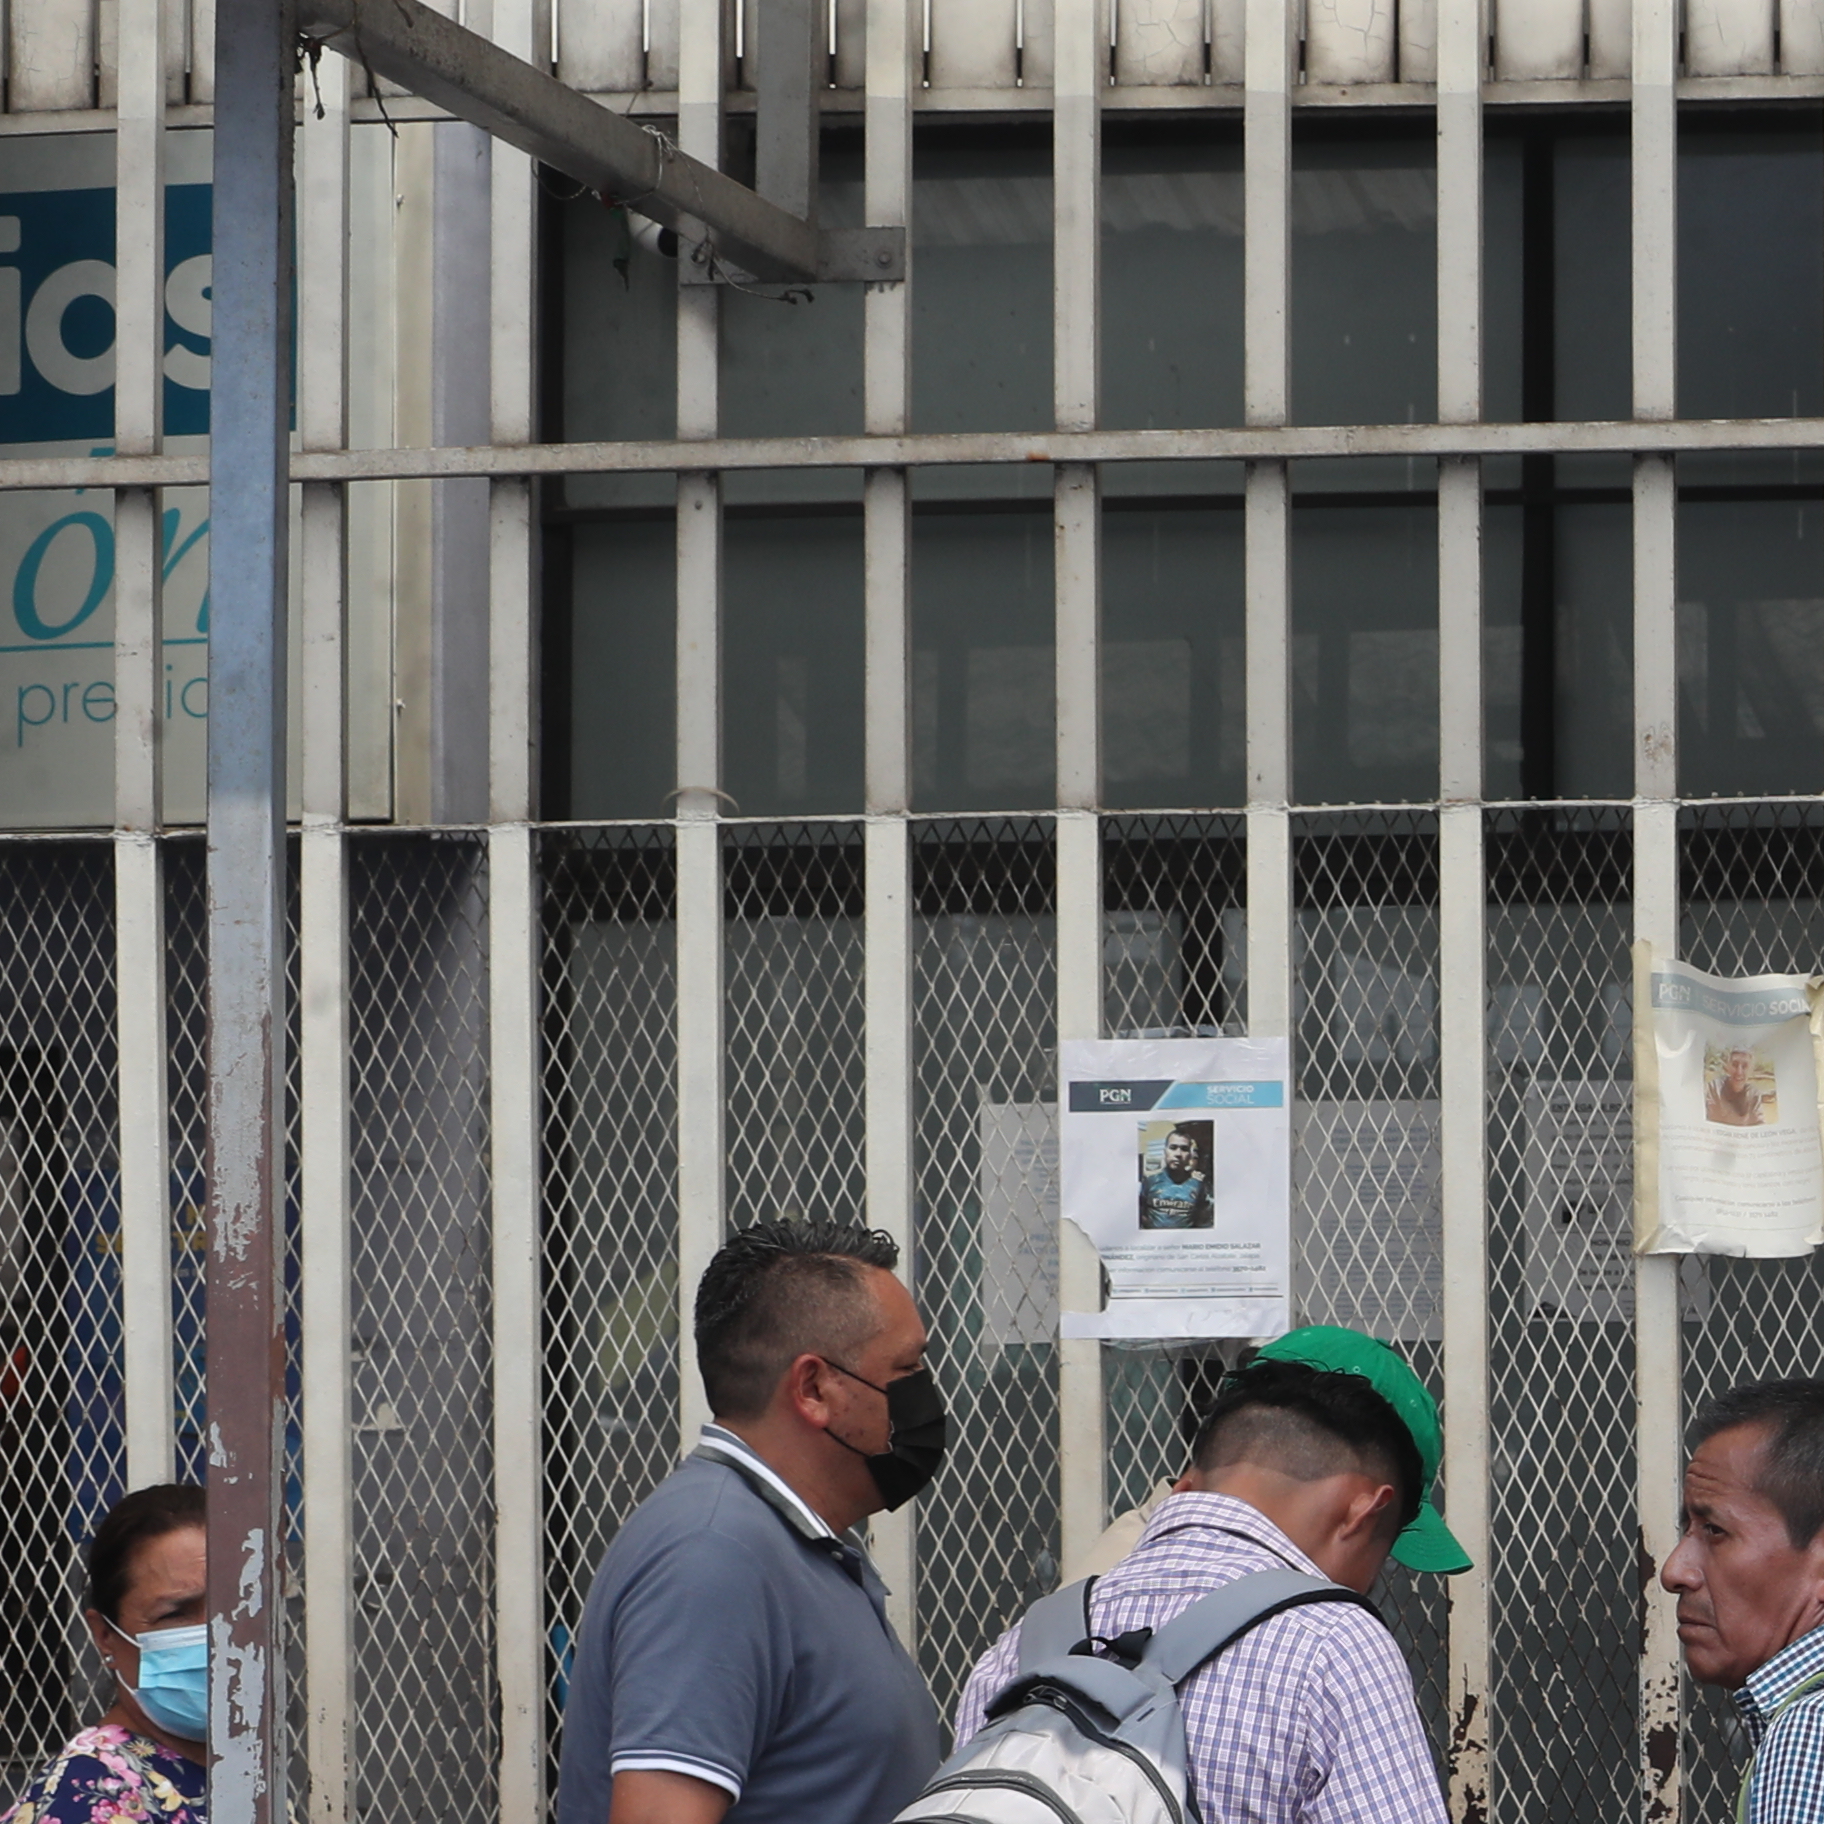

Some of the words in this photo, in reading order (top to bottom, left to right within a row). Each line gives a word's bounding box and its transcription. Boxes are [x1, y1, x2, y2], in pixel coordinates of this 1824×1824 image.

[1658, 983, 1691, 1002] PGN
[1703, 995, 1766, 1018] SERVICIO
[1100, 1088, 1132, 1102] PGN
[1207, 1085, 1254, 1094] SERVICIO
[1207, 1094, 1254, 1104] SOCIAL
